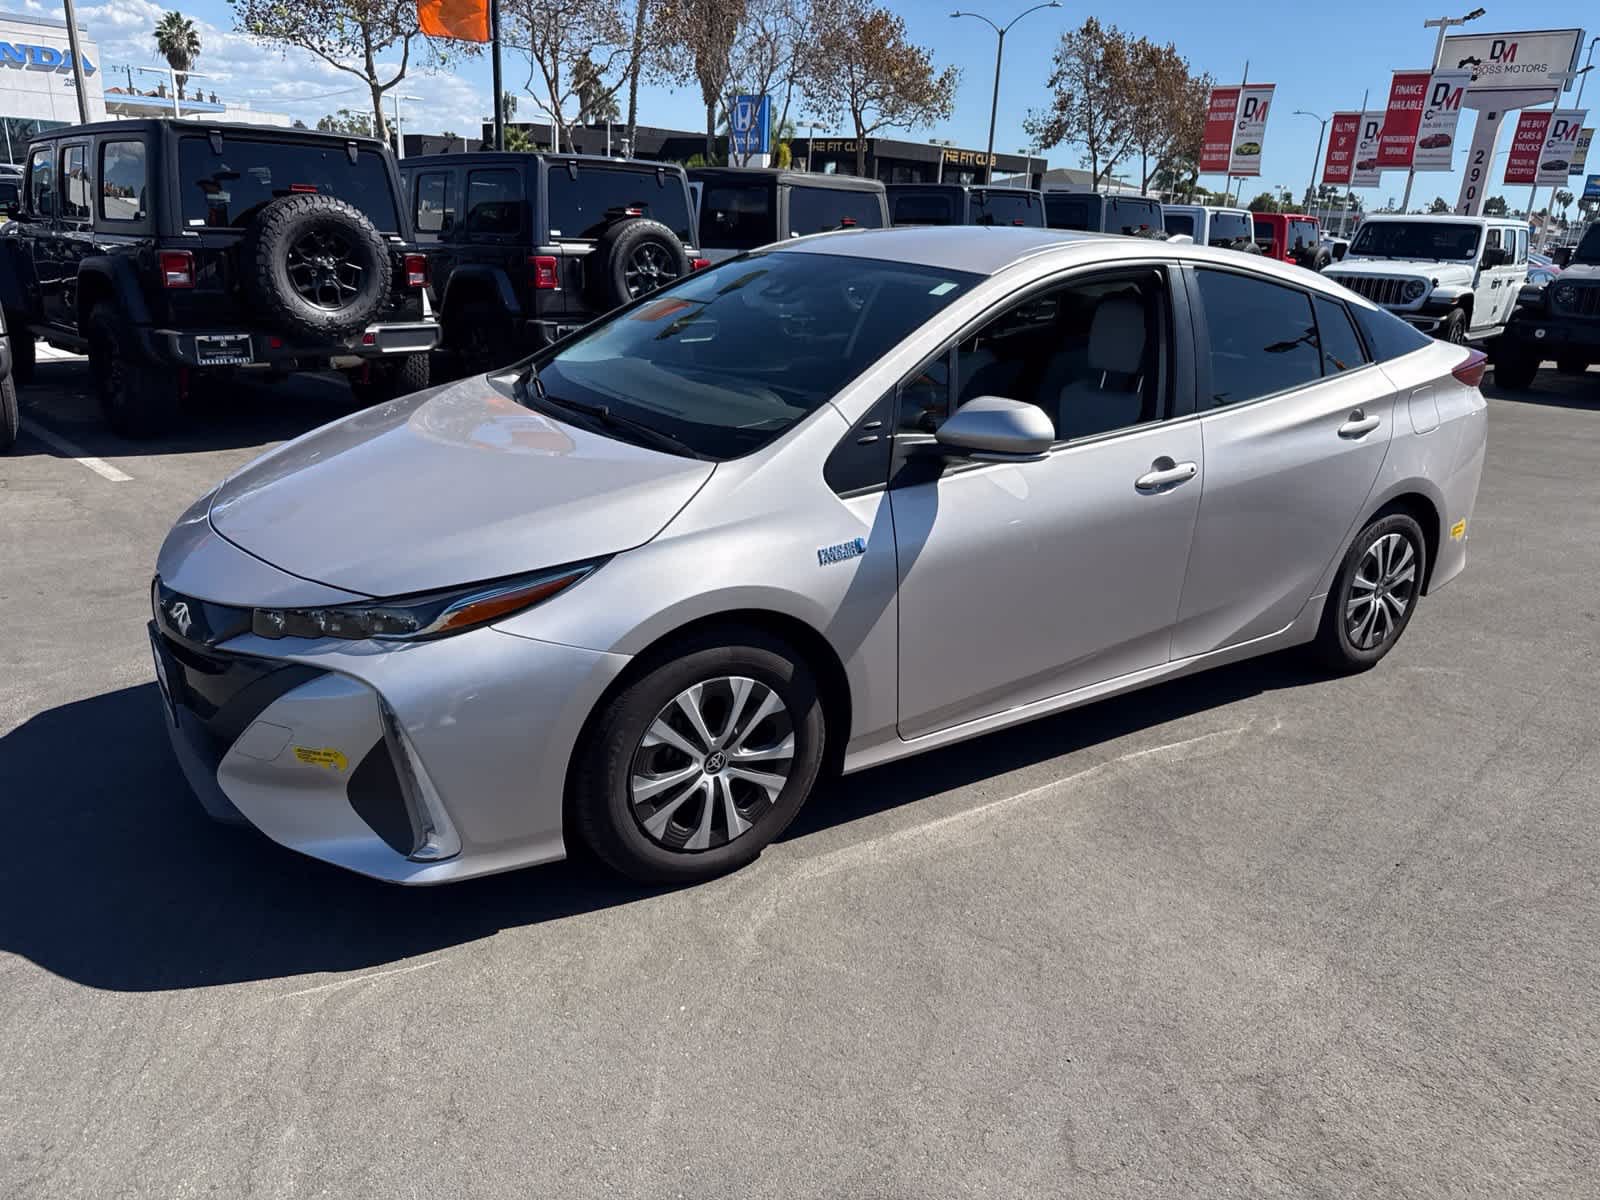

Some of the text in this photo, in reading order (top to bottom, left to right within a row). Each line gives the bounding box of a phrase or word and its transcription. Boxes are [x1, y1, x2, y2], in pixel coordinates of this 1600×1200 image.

[1505, 63, 1548, 74] MOTORS
[1395, 85, 1423, 95] FINANCE
[1389, 100, 1423, 111] AVAILABLE
[1520, 120, 1547, 128] WE BUY
[1518, 132, 1535, 140] CARS
[827, 142, 842, 152] FIT
[844, 142, 868, 152] CLB
[1514, 144, 1540, 152] TRUCKS
[960, 151, 975, 164] FIT
